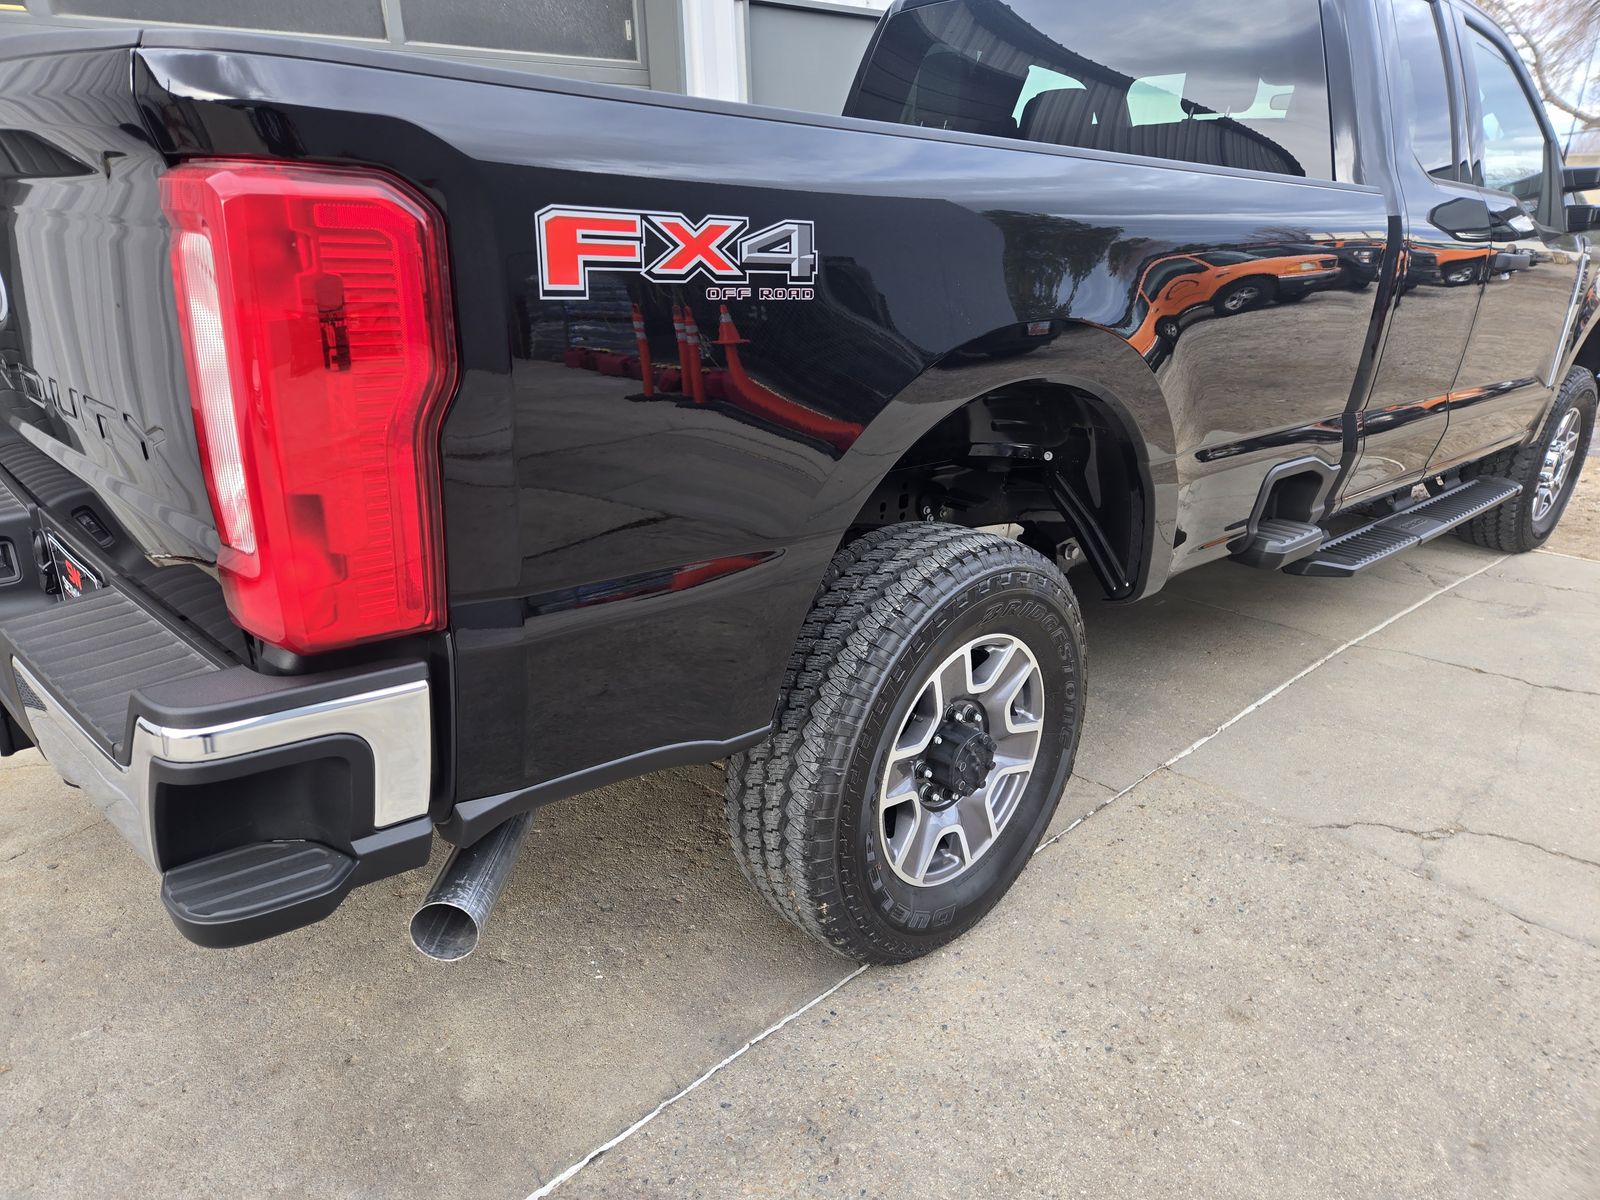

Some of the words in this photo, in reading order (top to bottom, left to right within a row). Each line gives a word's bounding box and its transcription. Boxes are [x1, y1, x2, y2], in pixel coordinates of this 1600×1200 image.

[535, 203, 818, 300] FX4
[706, 287, 751, 300] OFF
[759, 287, 814, 300] ROAD
[17, 362, 167, 462] DUTY
[977, 598, 1077, 750] BRIDGESTONE
